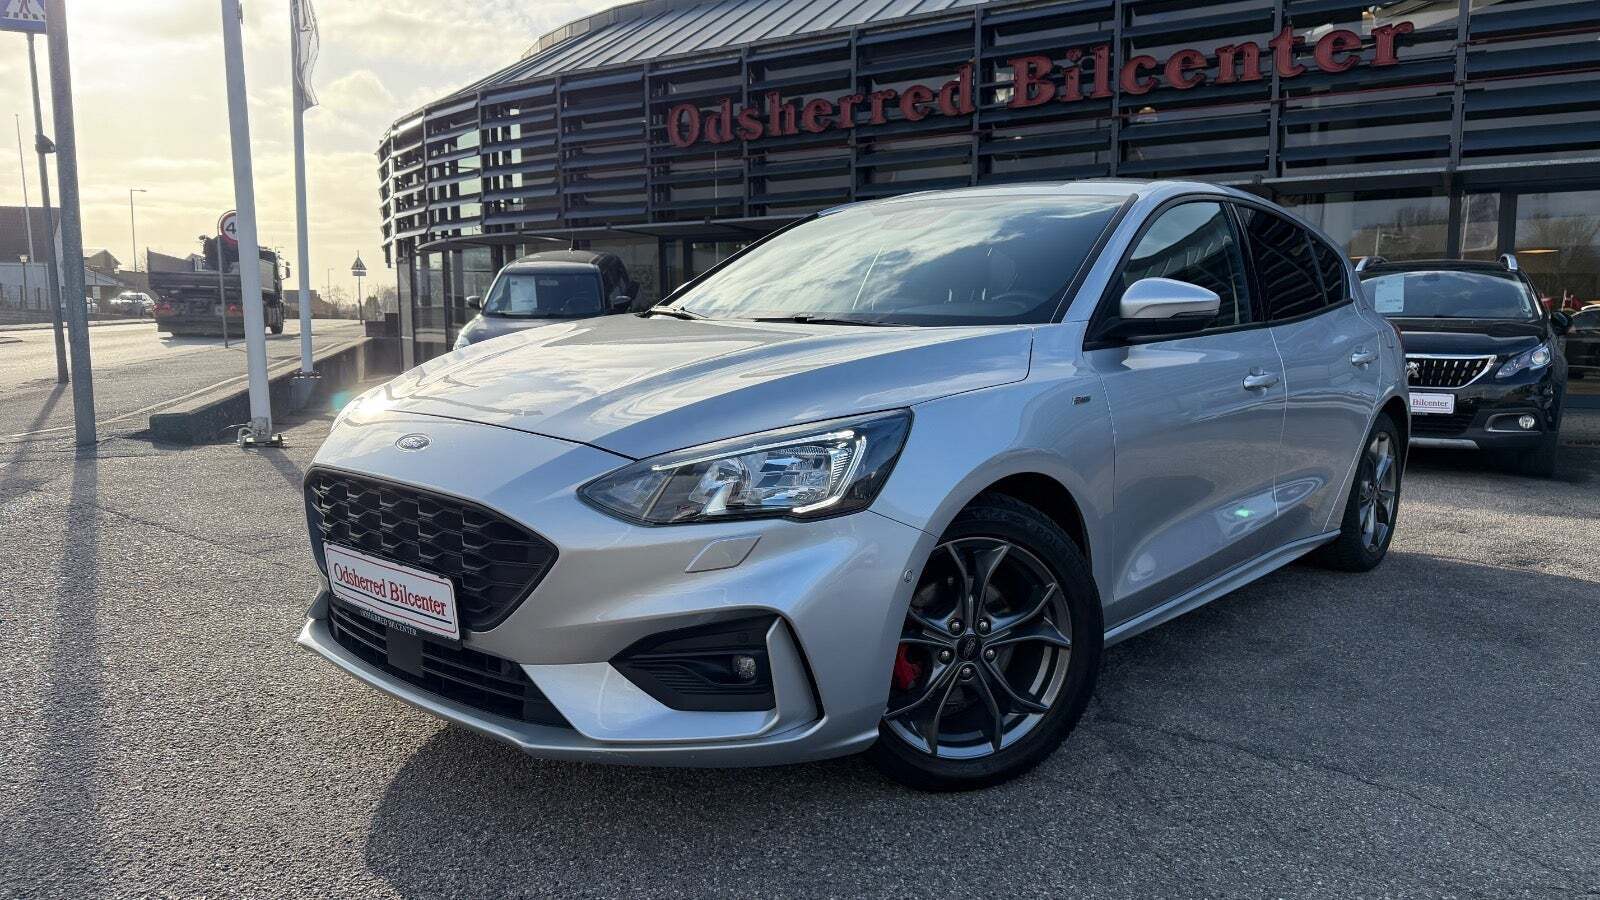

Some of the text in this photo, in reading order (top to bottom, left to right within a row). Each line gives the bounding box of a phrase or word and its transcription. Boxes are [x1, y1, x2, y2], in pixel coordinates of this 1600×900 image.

[667, 20, 1415, 147] Odsherred Bilcenter
[1412, 398, 1449, 407] Bilcenter
[333, 562, 447, 616] Odsherred Bilcenter
